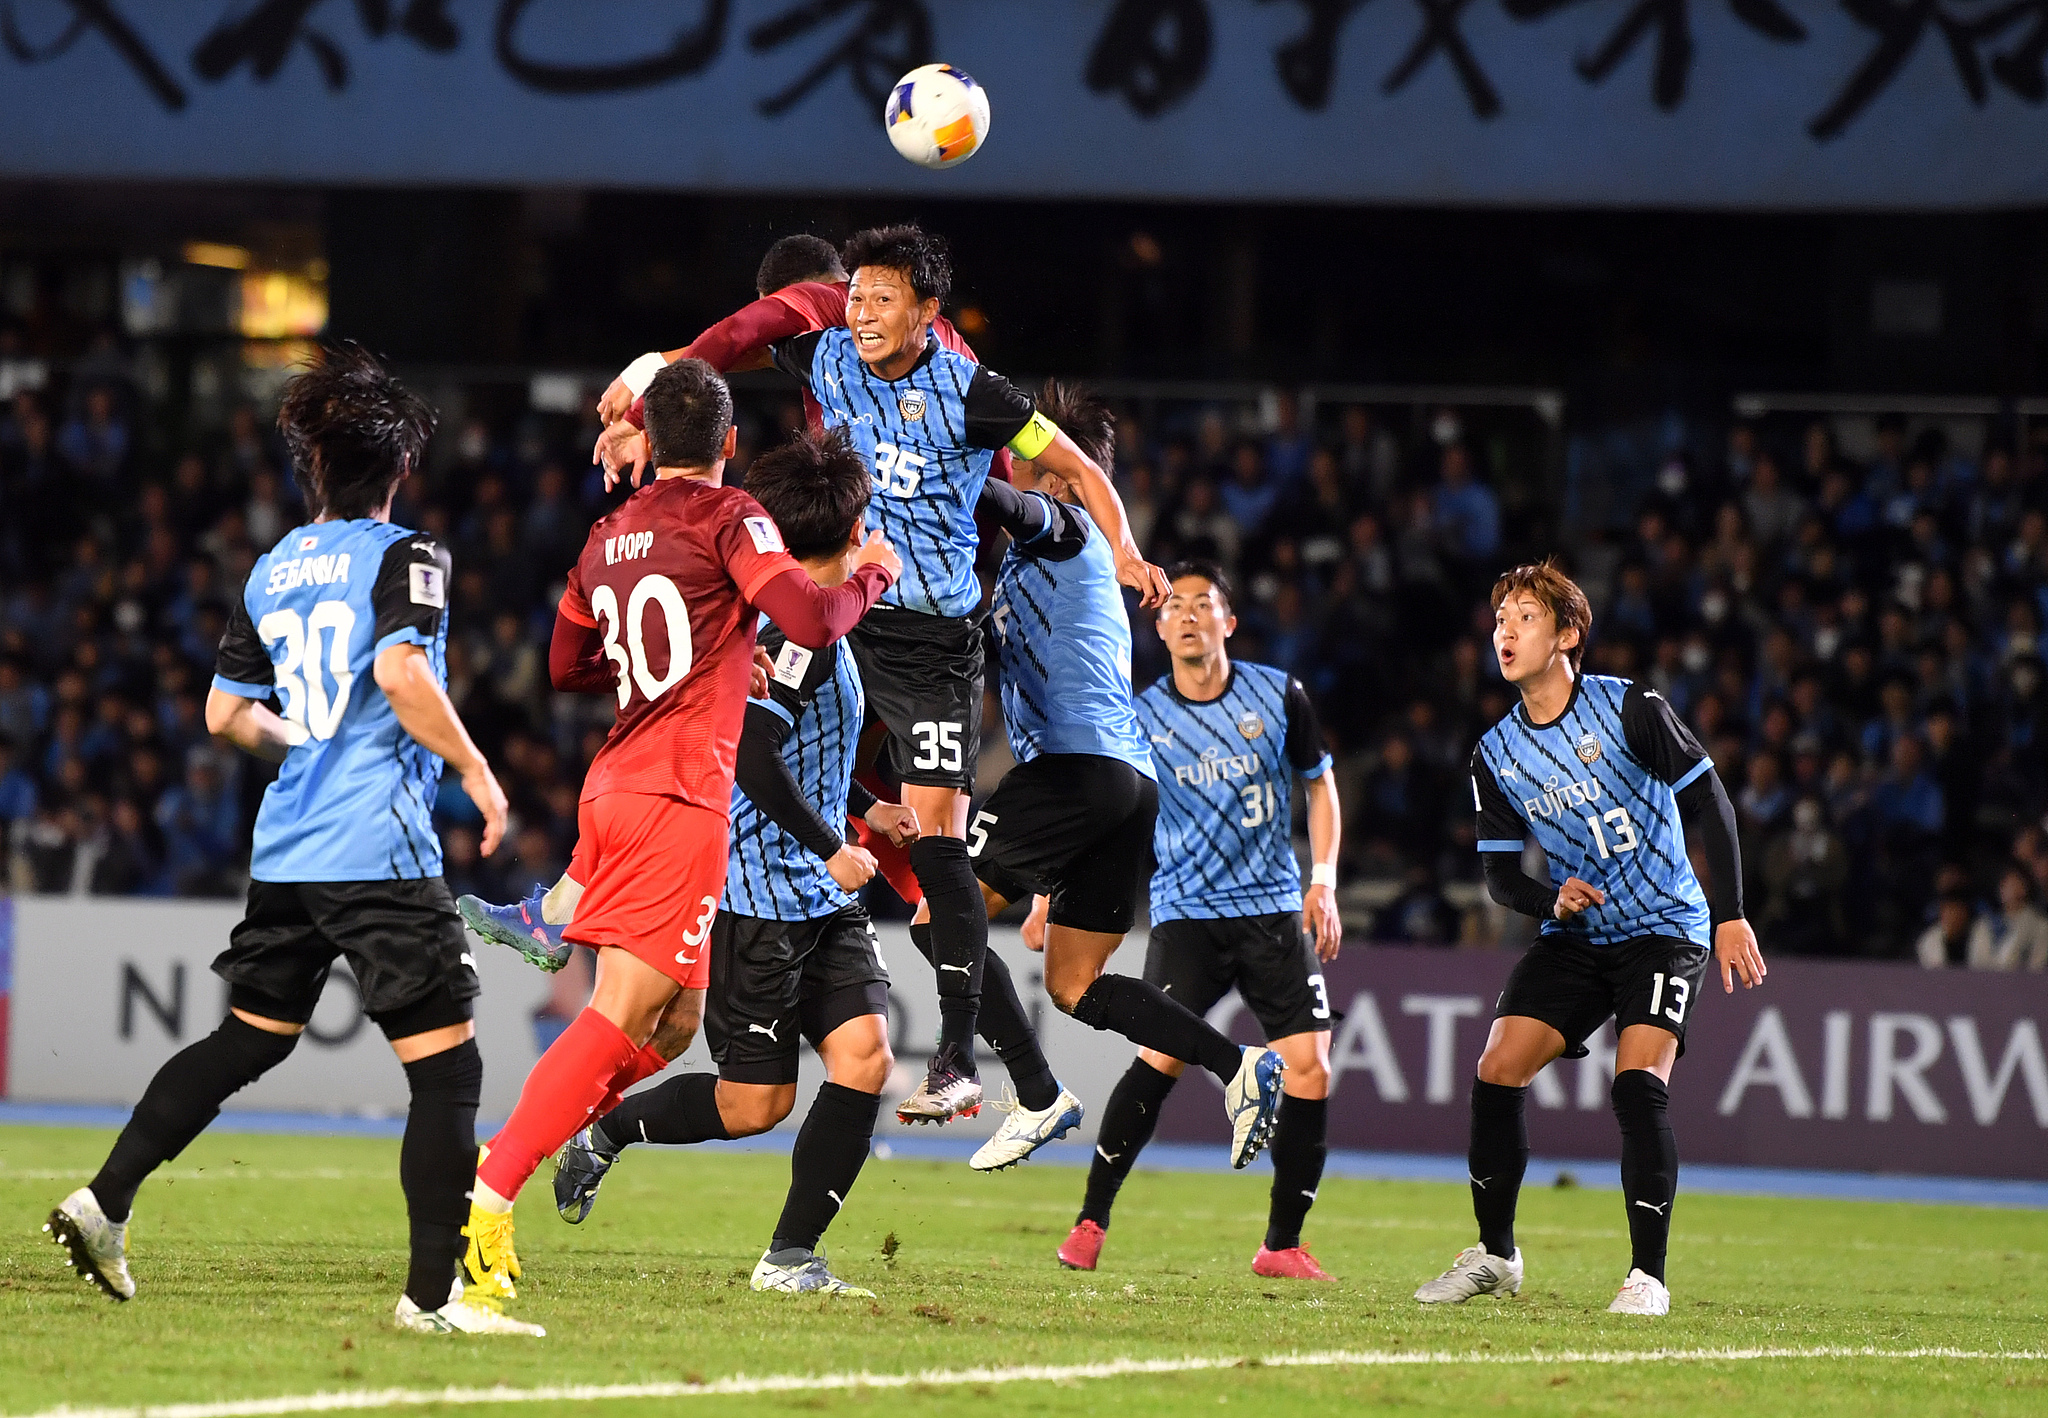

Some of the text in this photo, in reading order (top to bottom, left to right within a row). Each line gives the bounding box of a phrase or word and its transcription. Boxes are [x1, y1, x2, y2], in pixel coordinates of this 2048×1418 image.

[870, 442, 927, 499] 35
[605, 530, 654, 566] W.POPP
[265, 553, 351, 596] SEGAWA
[591, 574, 693, 710] 30
[257, 600, 356, 746] 30
[911, 721, 963, 772] 35
[1174, 751, 1260, 788] FUJITSU
[1240, 781, 1275, 828] 31
[1523, 776, 1601, 822] FUJITSU
[1588, 807, 1637, 859] 13
[1649, 972, 1690, 1025] 13
